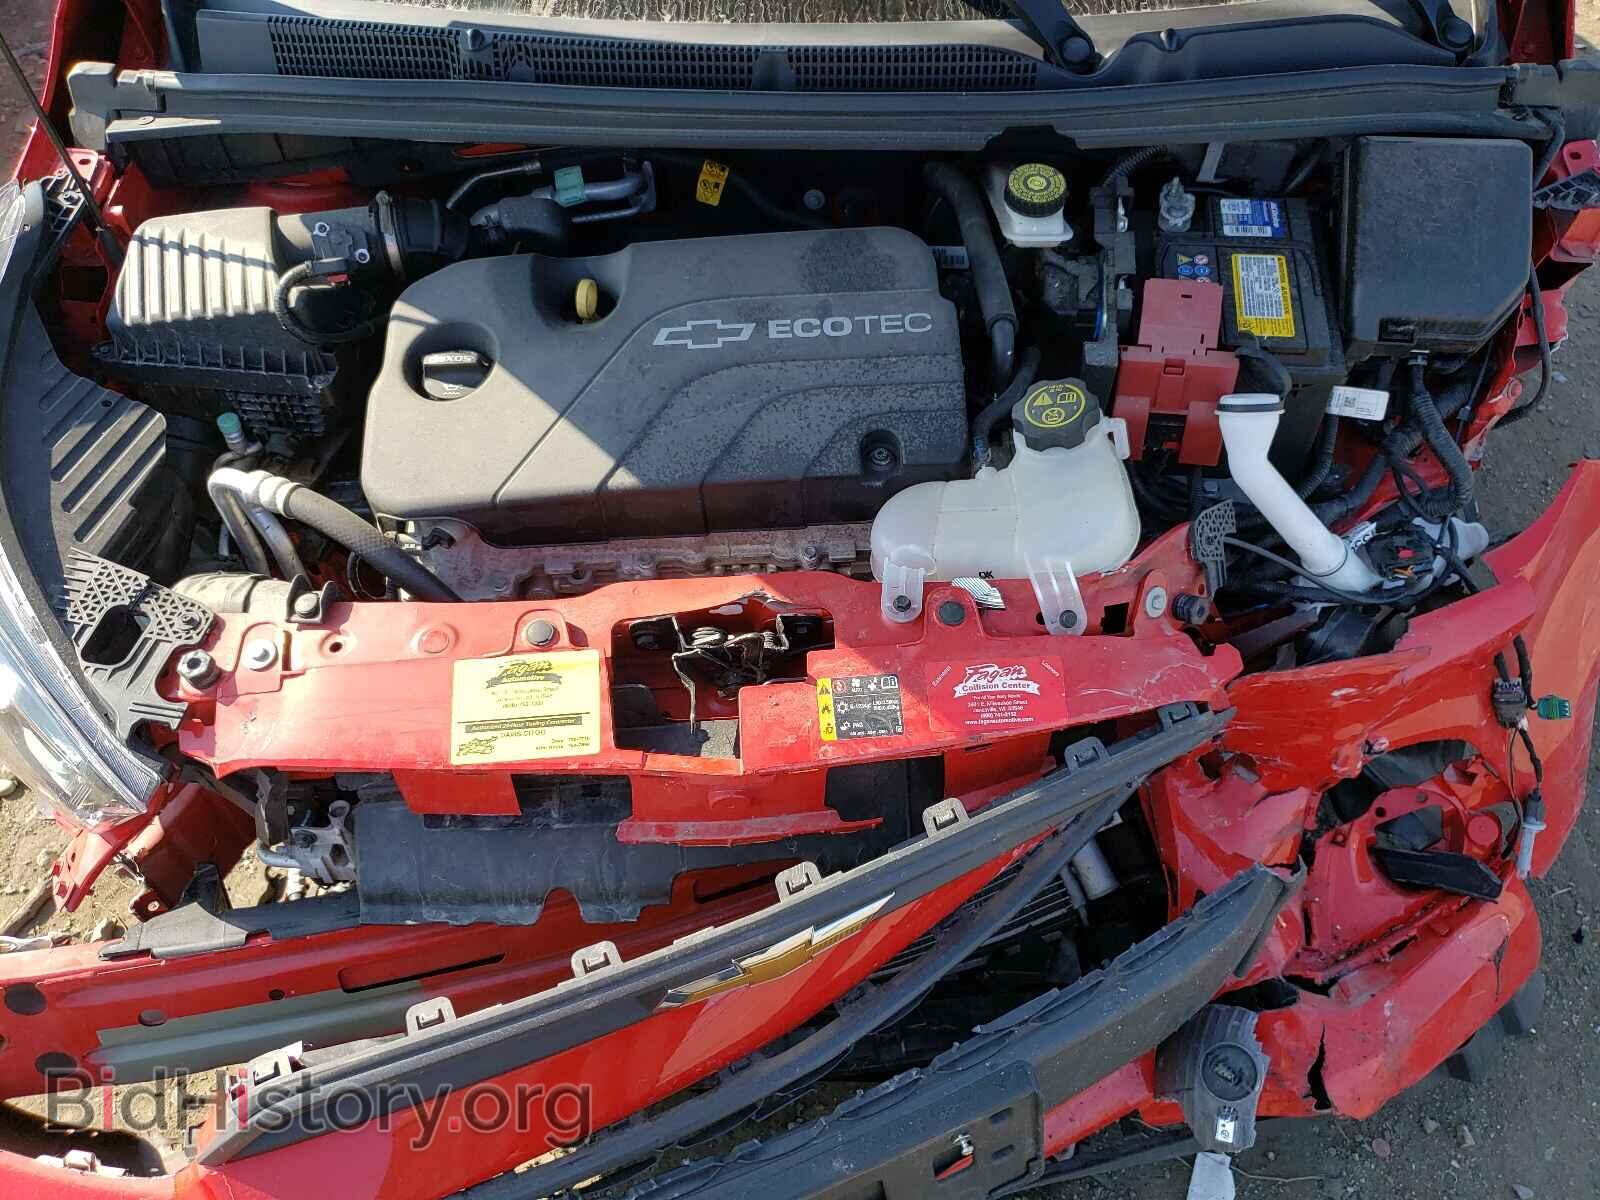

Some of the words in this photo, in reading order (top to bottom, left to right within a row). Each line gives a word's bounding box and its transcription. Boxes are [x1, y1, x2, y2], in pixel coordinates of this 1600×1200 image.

[768, 313, 932, 339] ECOTEC
[963, 663, 1028, 684] Fagan
[962, 682, 999, 691] Collision
